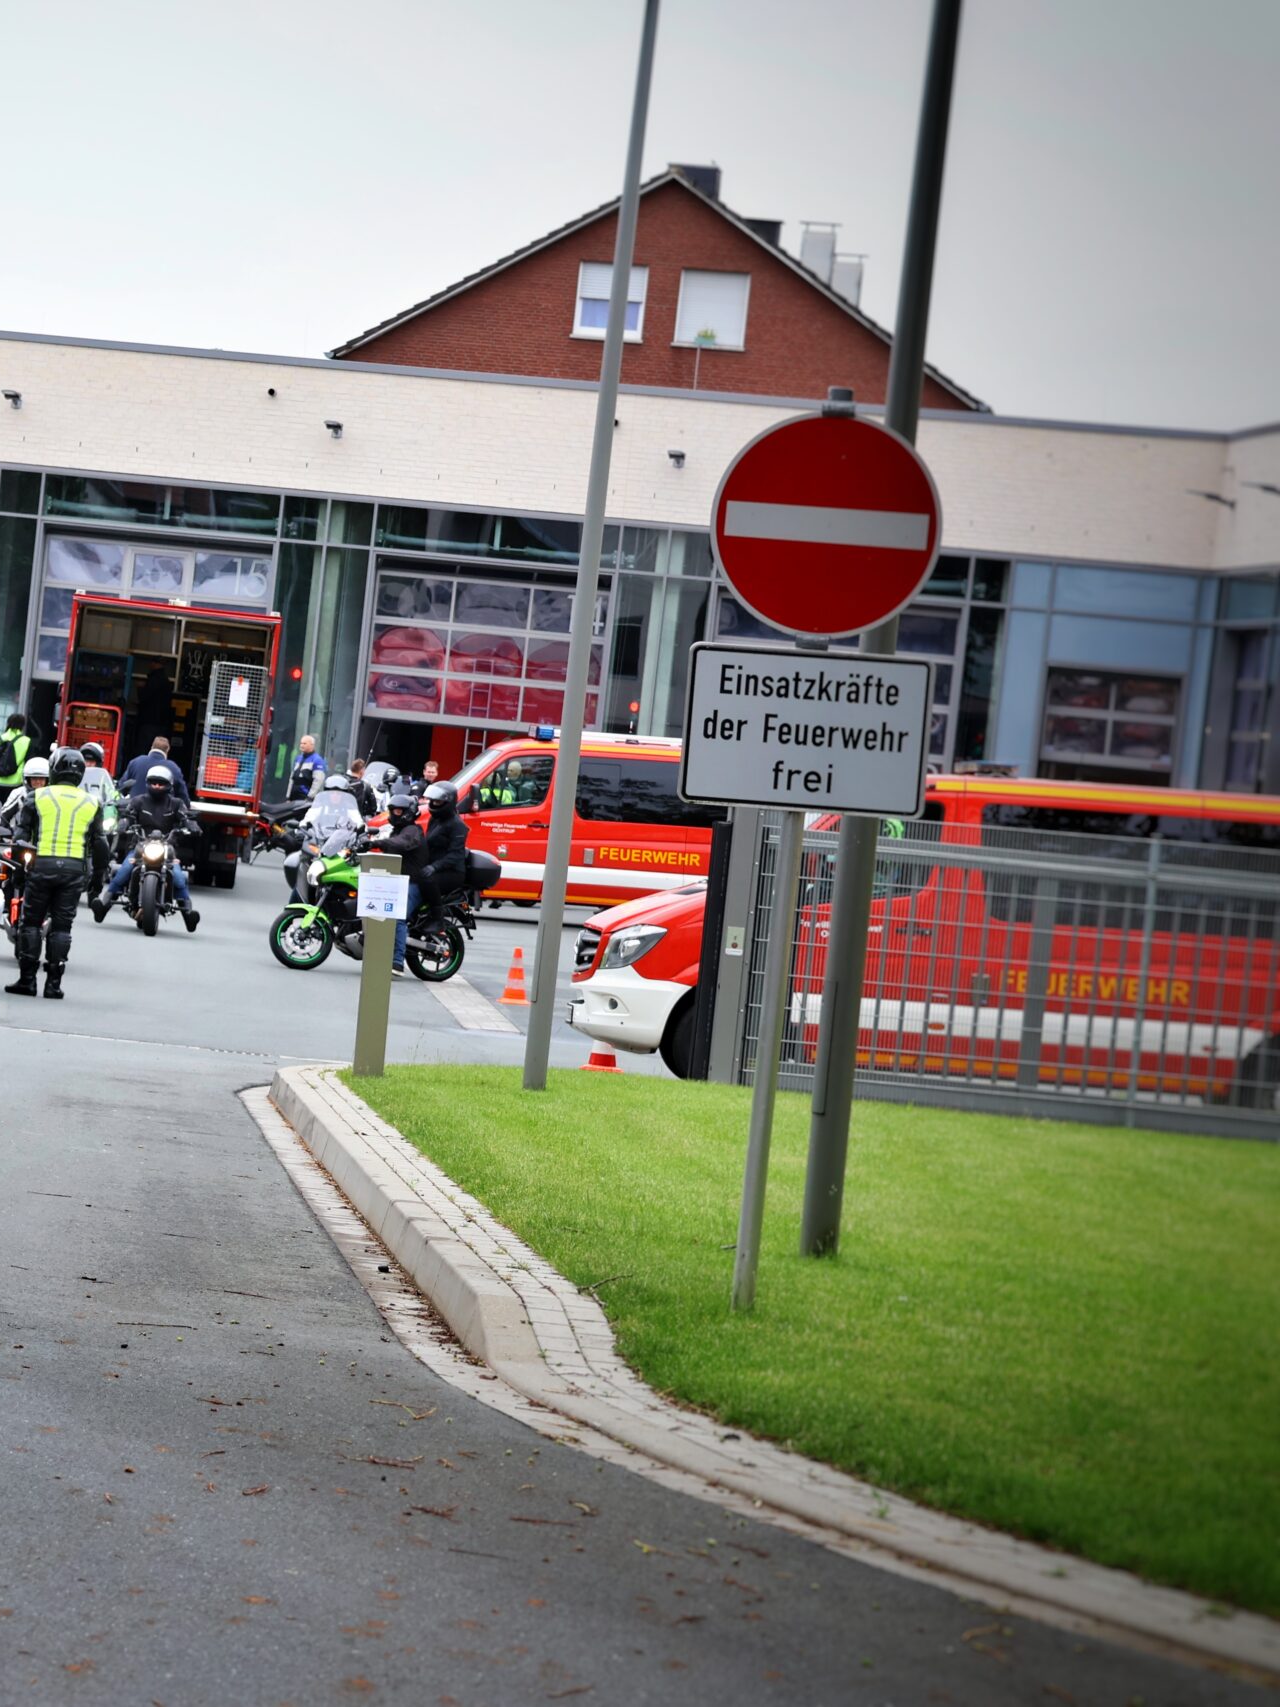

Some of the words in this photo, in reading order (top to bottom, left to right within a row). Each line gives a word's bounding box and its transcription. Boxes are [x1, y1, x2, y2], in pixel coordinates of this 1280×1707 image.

[233, 558, 271, 598] 15
[719, 664, 899, 706] Einsatzkräfte
[703, 709, 748, 741] der
[762, 713, 909, 753] Feuerwehr
[772, 760, 833, 794] frei
[600, 847, 700, 866] FEUERWEHR
